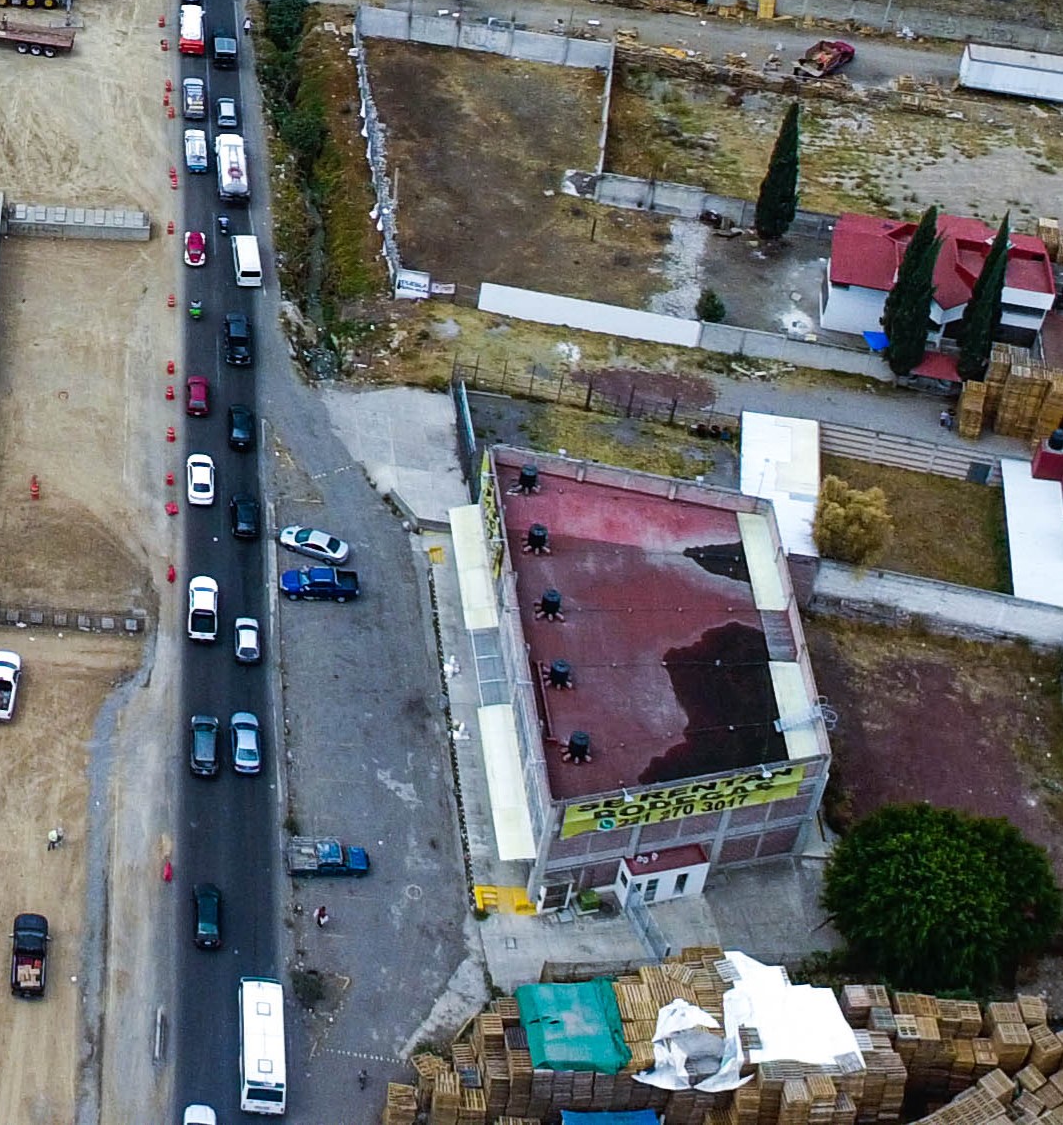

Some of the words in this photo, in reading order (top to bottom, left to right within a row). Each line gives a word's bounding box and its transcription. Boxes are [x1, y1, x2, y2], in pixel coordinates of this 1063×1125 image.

[577, 799, 624, 812] SE
[639, 767, 793, 802] RENTAN
[594, 782, 774, 820] BODEGAS
[701, 794, 749, 813] 3017
